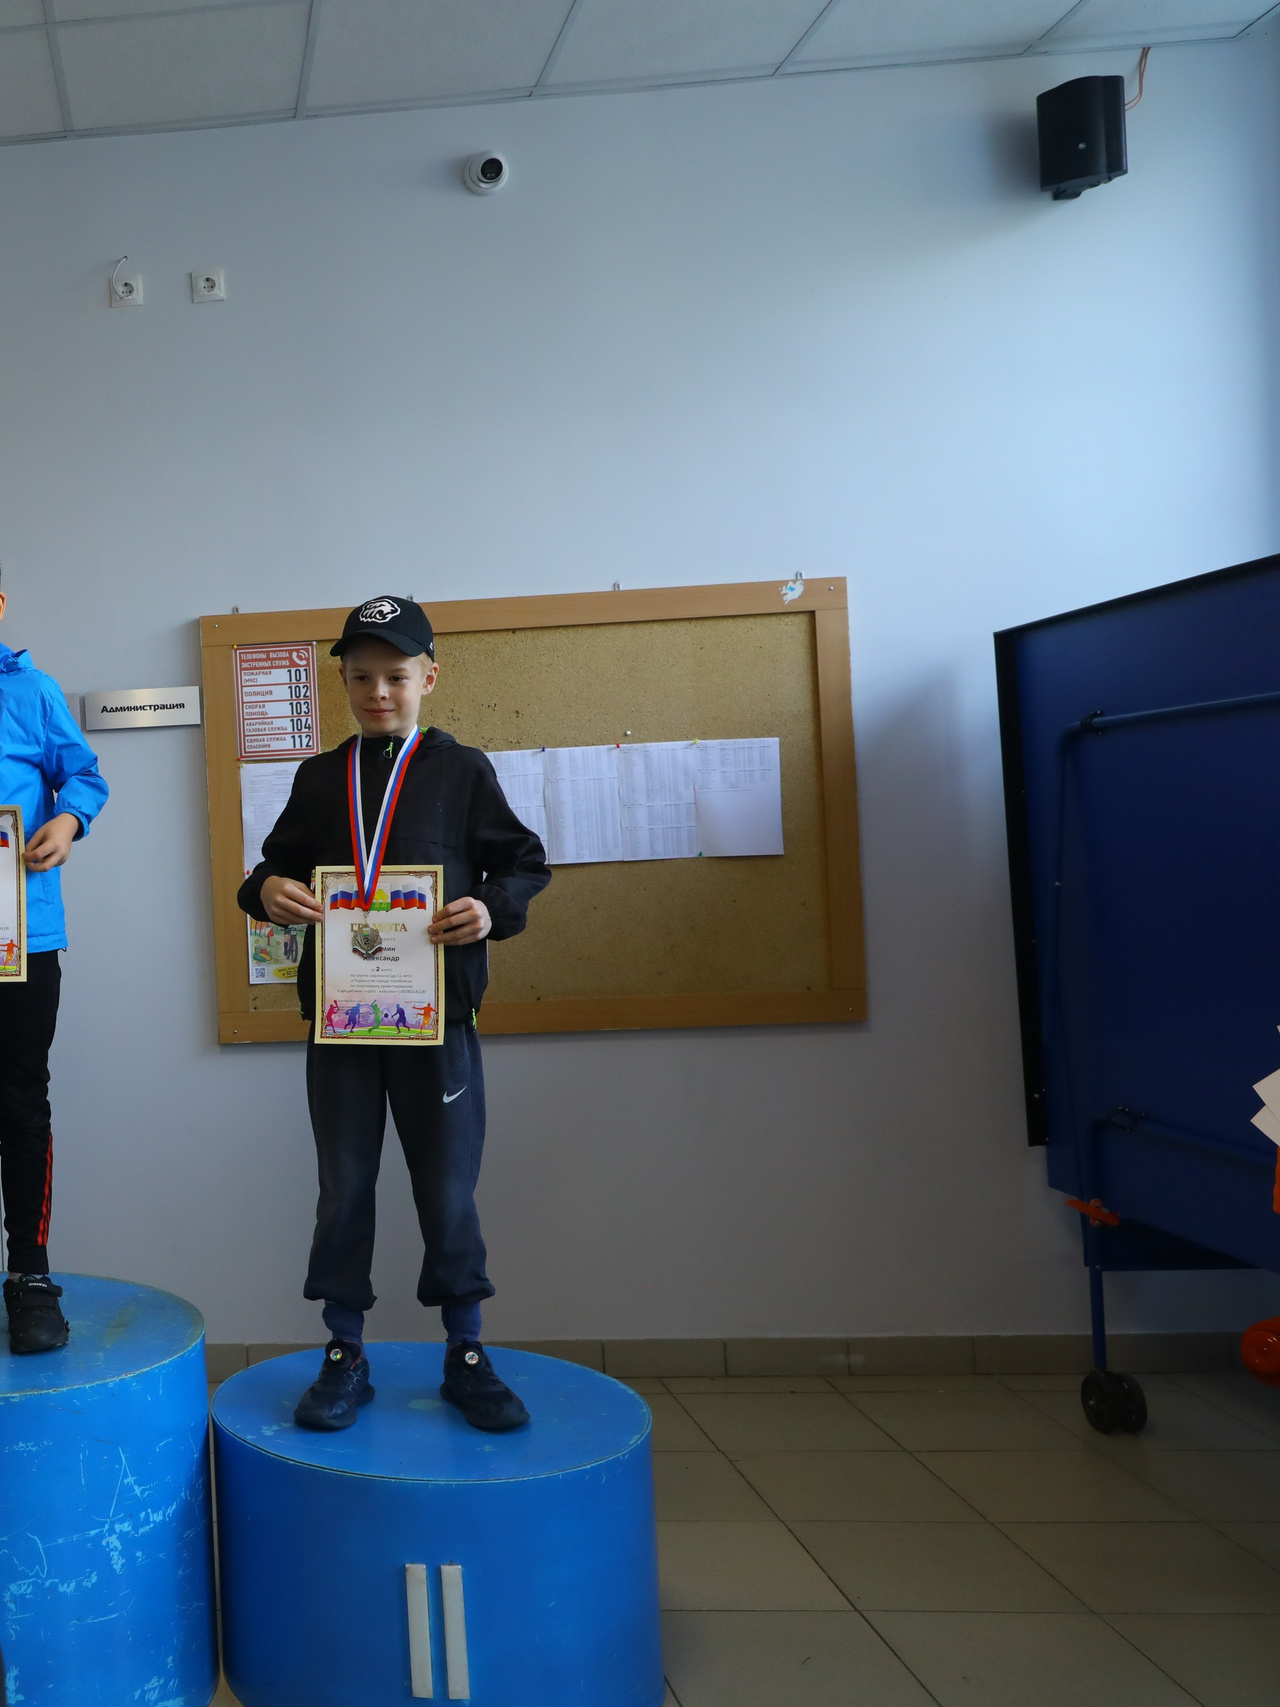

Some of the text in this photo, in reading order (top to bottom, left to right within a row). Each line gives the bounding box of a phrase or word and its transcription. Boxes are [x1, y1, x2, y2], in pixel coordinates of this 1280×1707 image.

[287, 668, 309, 682] 101
[244, 690, 273, 698] ПОЛИЦИЯ
[288, 684, 310, 699] 102
[100, 702, 185, 713] Администрация
[289, 701, 310, 716] 103
[290, 718, 312, 732] 104
[291, 734, 312, 749] 112
